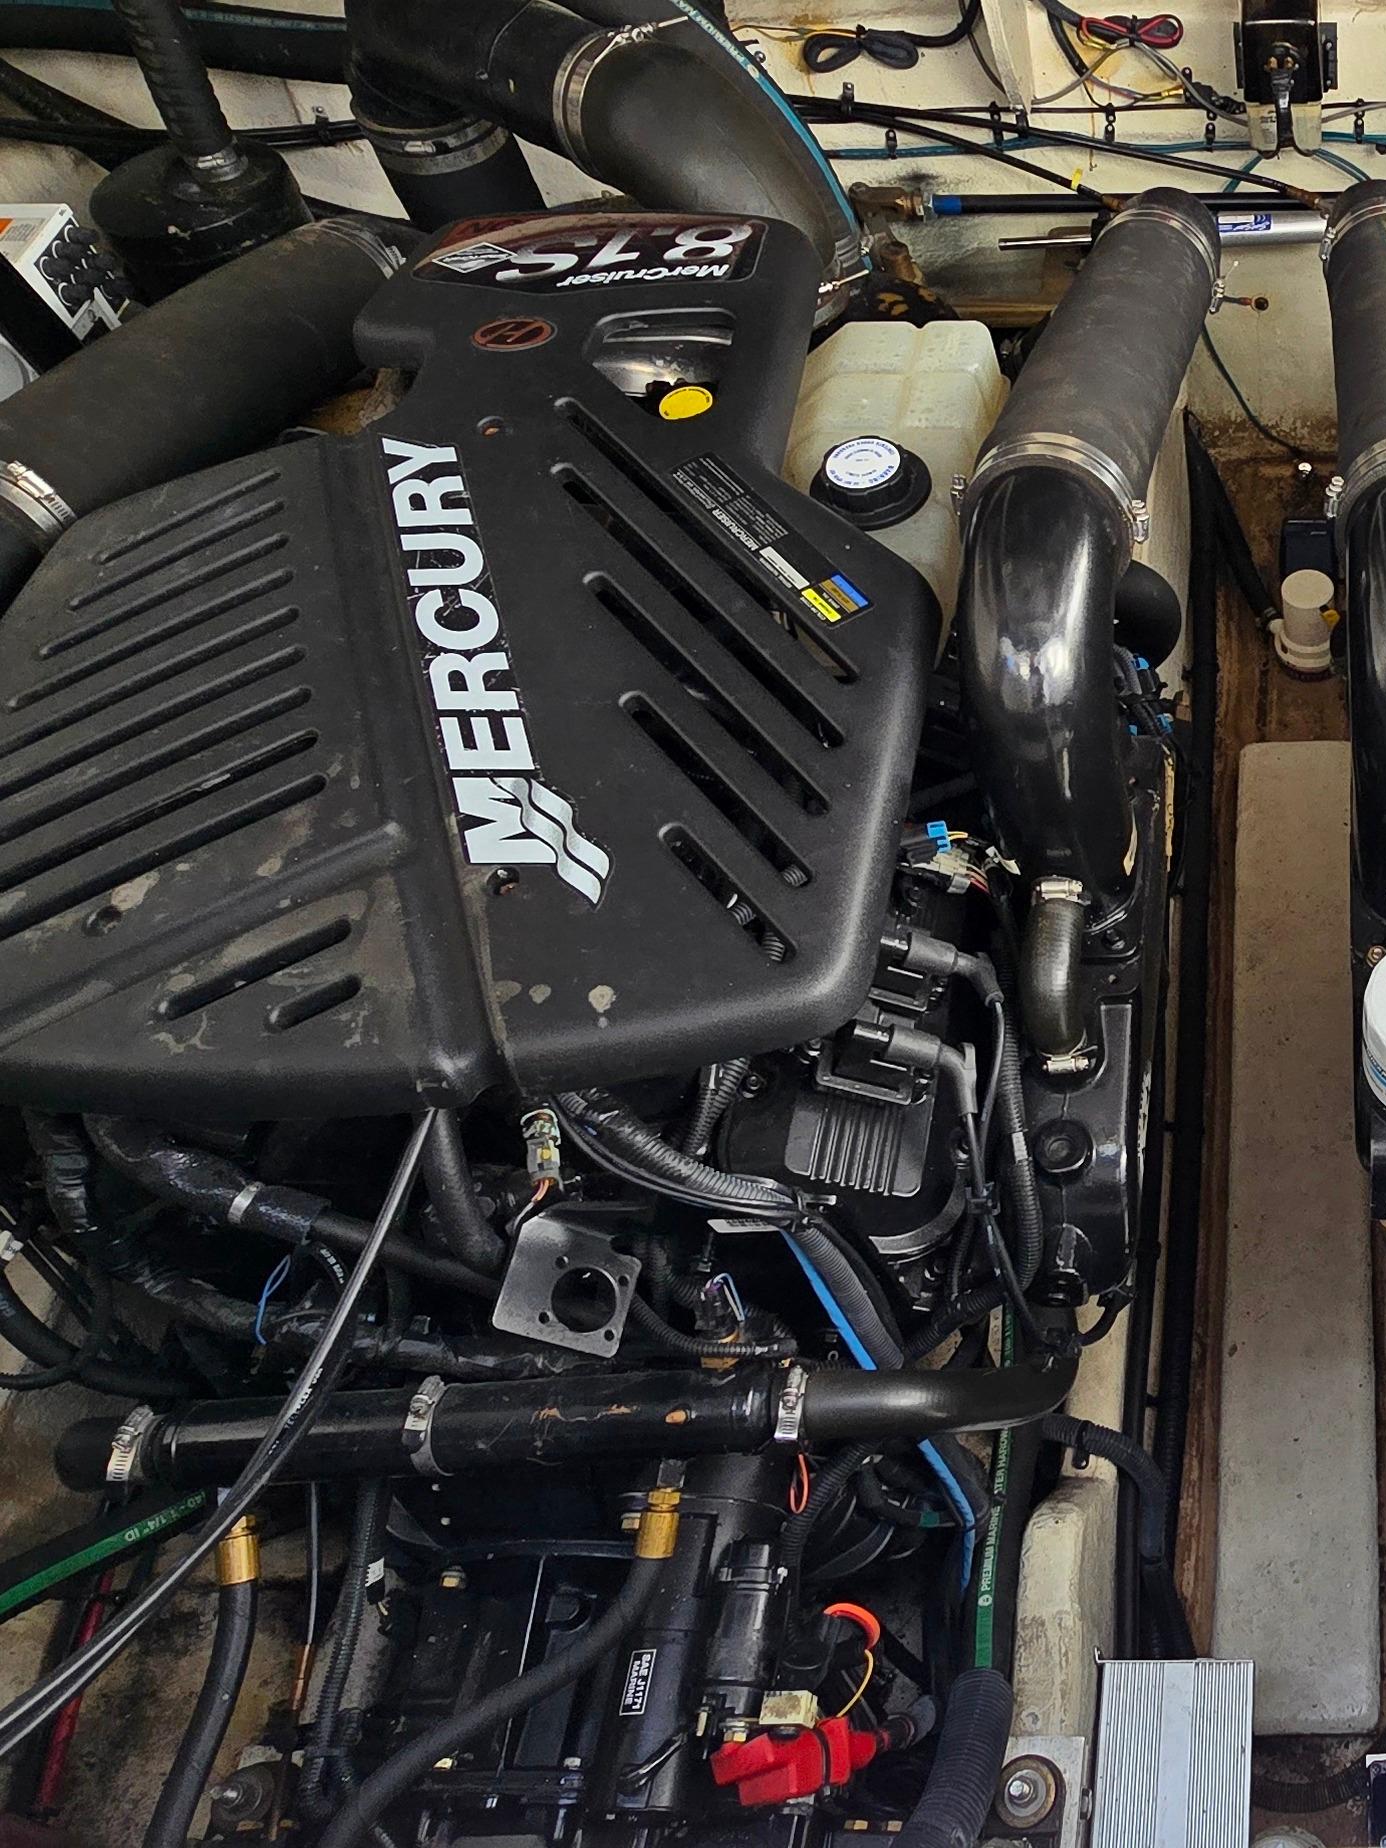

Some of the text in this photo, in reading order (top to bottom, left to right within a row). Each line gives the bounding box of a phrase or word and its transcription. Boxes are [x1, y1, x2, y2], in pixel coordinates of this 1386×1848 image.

[555, 263, 730, 287] MerCruiser
[711, 507, 759, 550] MERCRUISER
[382, 437, 612, 909] MERCURY
[122, 1527, 141, 1543] ID
[985, 1504, 1002, 1545] MARINE
[980, 1544, 996, 1591] PREMIUM
[623, 1659, 640, 1705] MARINE
[631, 1652, 651, 1710] SAE J1171
